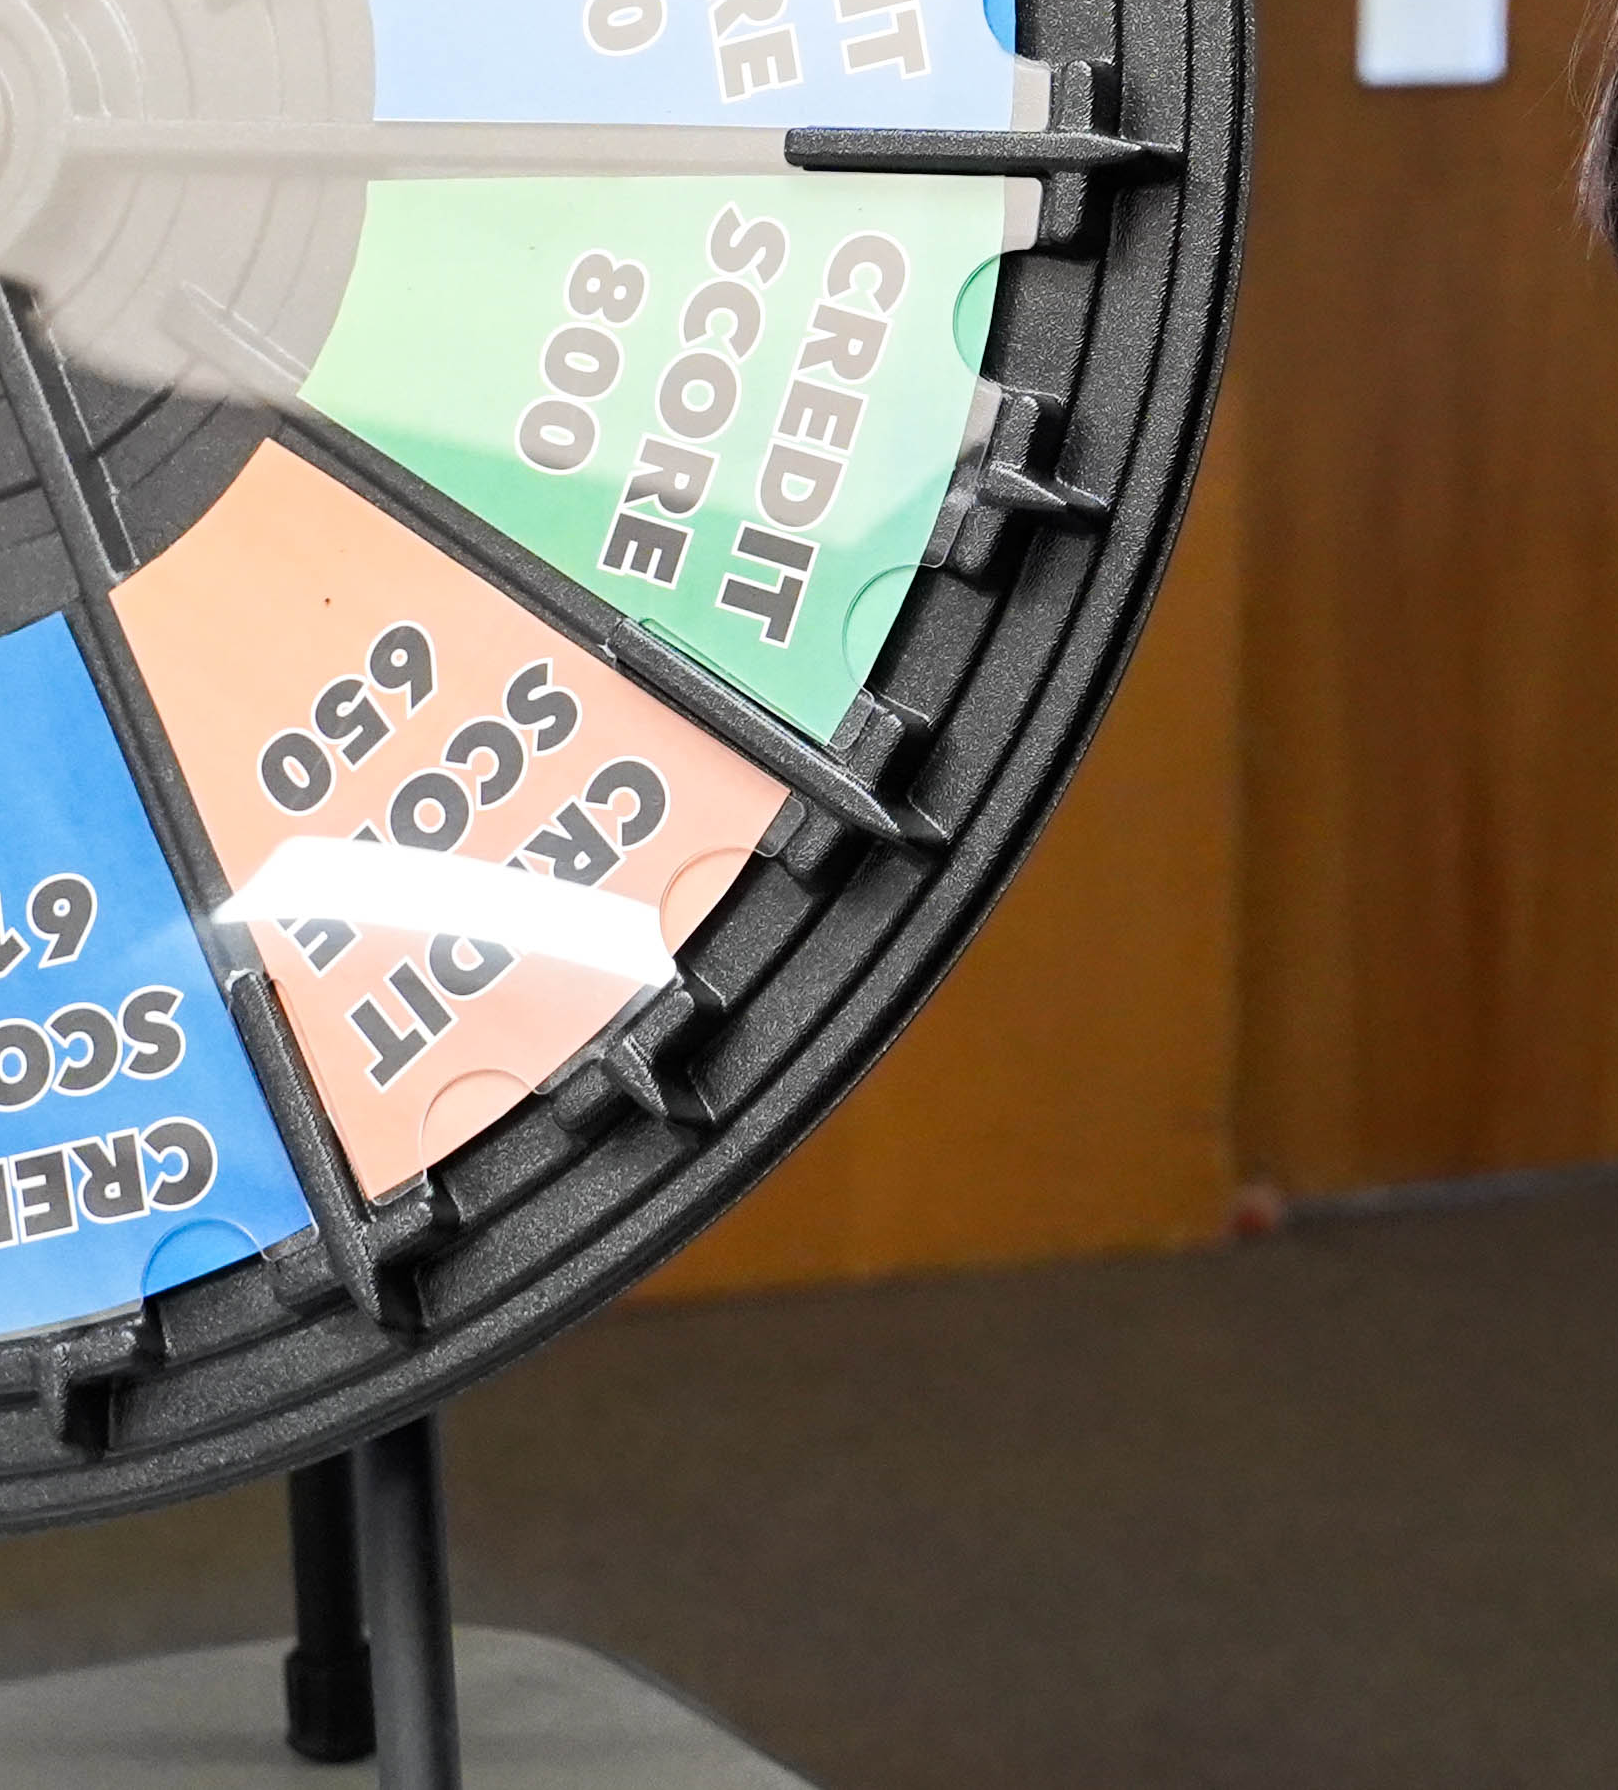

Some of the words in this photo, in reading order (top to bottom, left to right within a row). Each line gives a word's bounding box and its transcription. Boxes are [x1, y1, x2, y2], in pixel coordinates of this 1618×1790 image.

[518, 250, 646, 473] 800
[600, 204, 783, 586] SCORE
[717, 233, 905, 646] CREDIT
[261, 622, 436, 811] 650
[347, 758, 669, 1090] CRDIT
